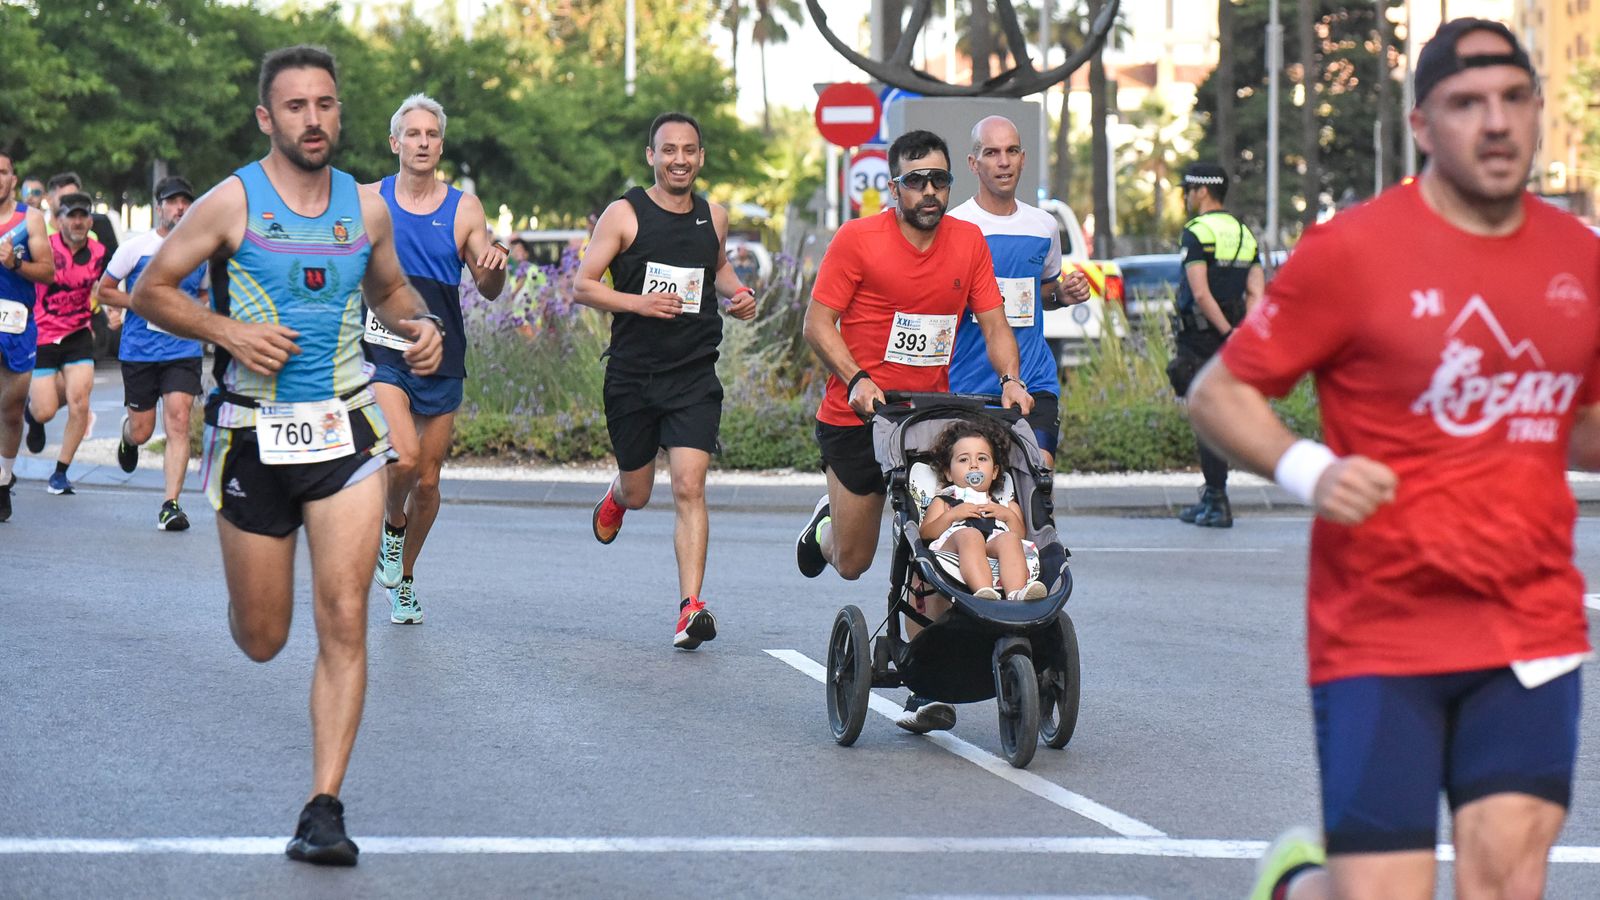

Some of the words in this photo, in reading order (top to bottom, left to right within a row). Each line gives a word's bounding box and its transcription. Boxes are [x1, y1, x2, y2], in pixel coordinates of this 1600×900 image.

[855, 172, 889, 192] 30
[647, 279, 677, 294] 220
[370, 316, 390, 334] 54
[896, 317, 911, 327] XXI
[894, 331, 927, 352] 393
[270, 422, 312, 446] 760
